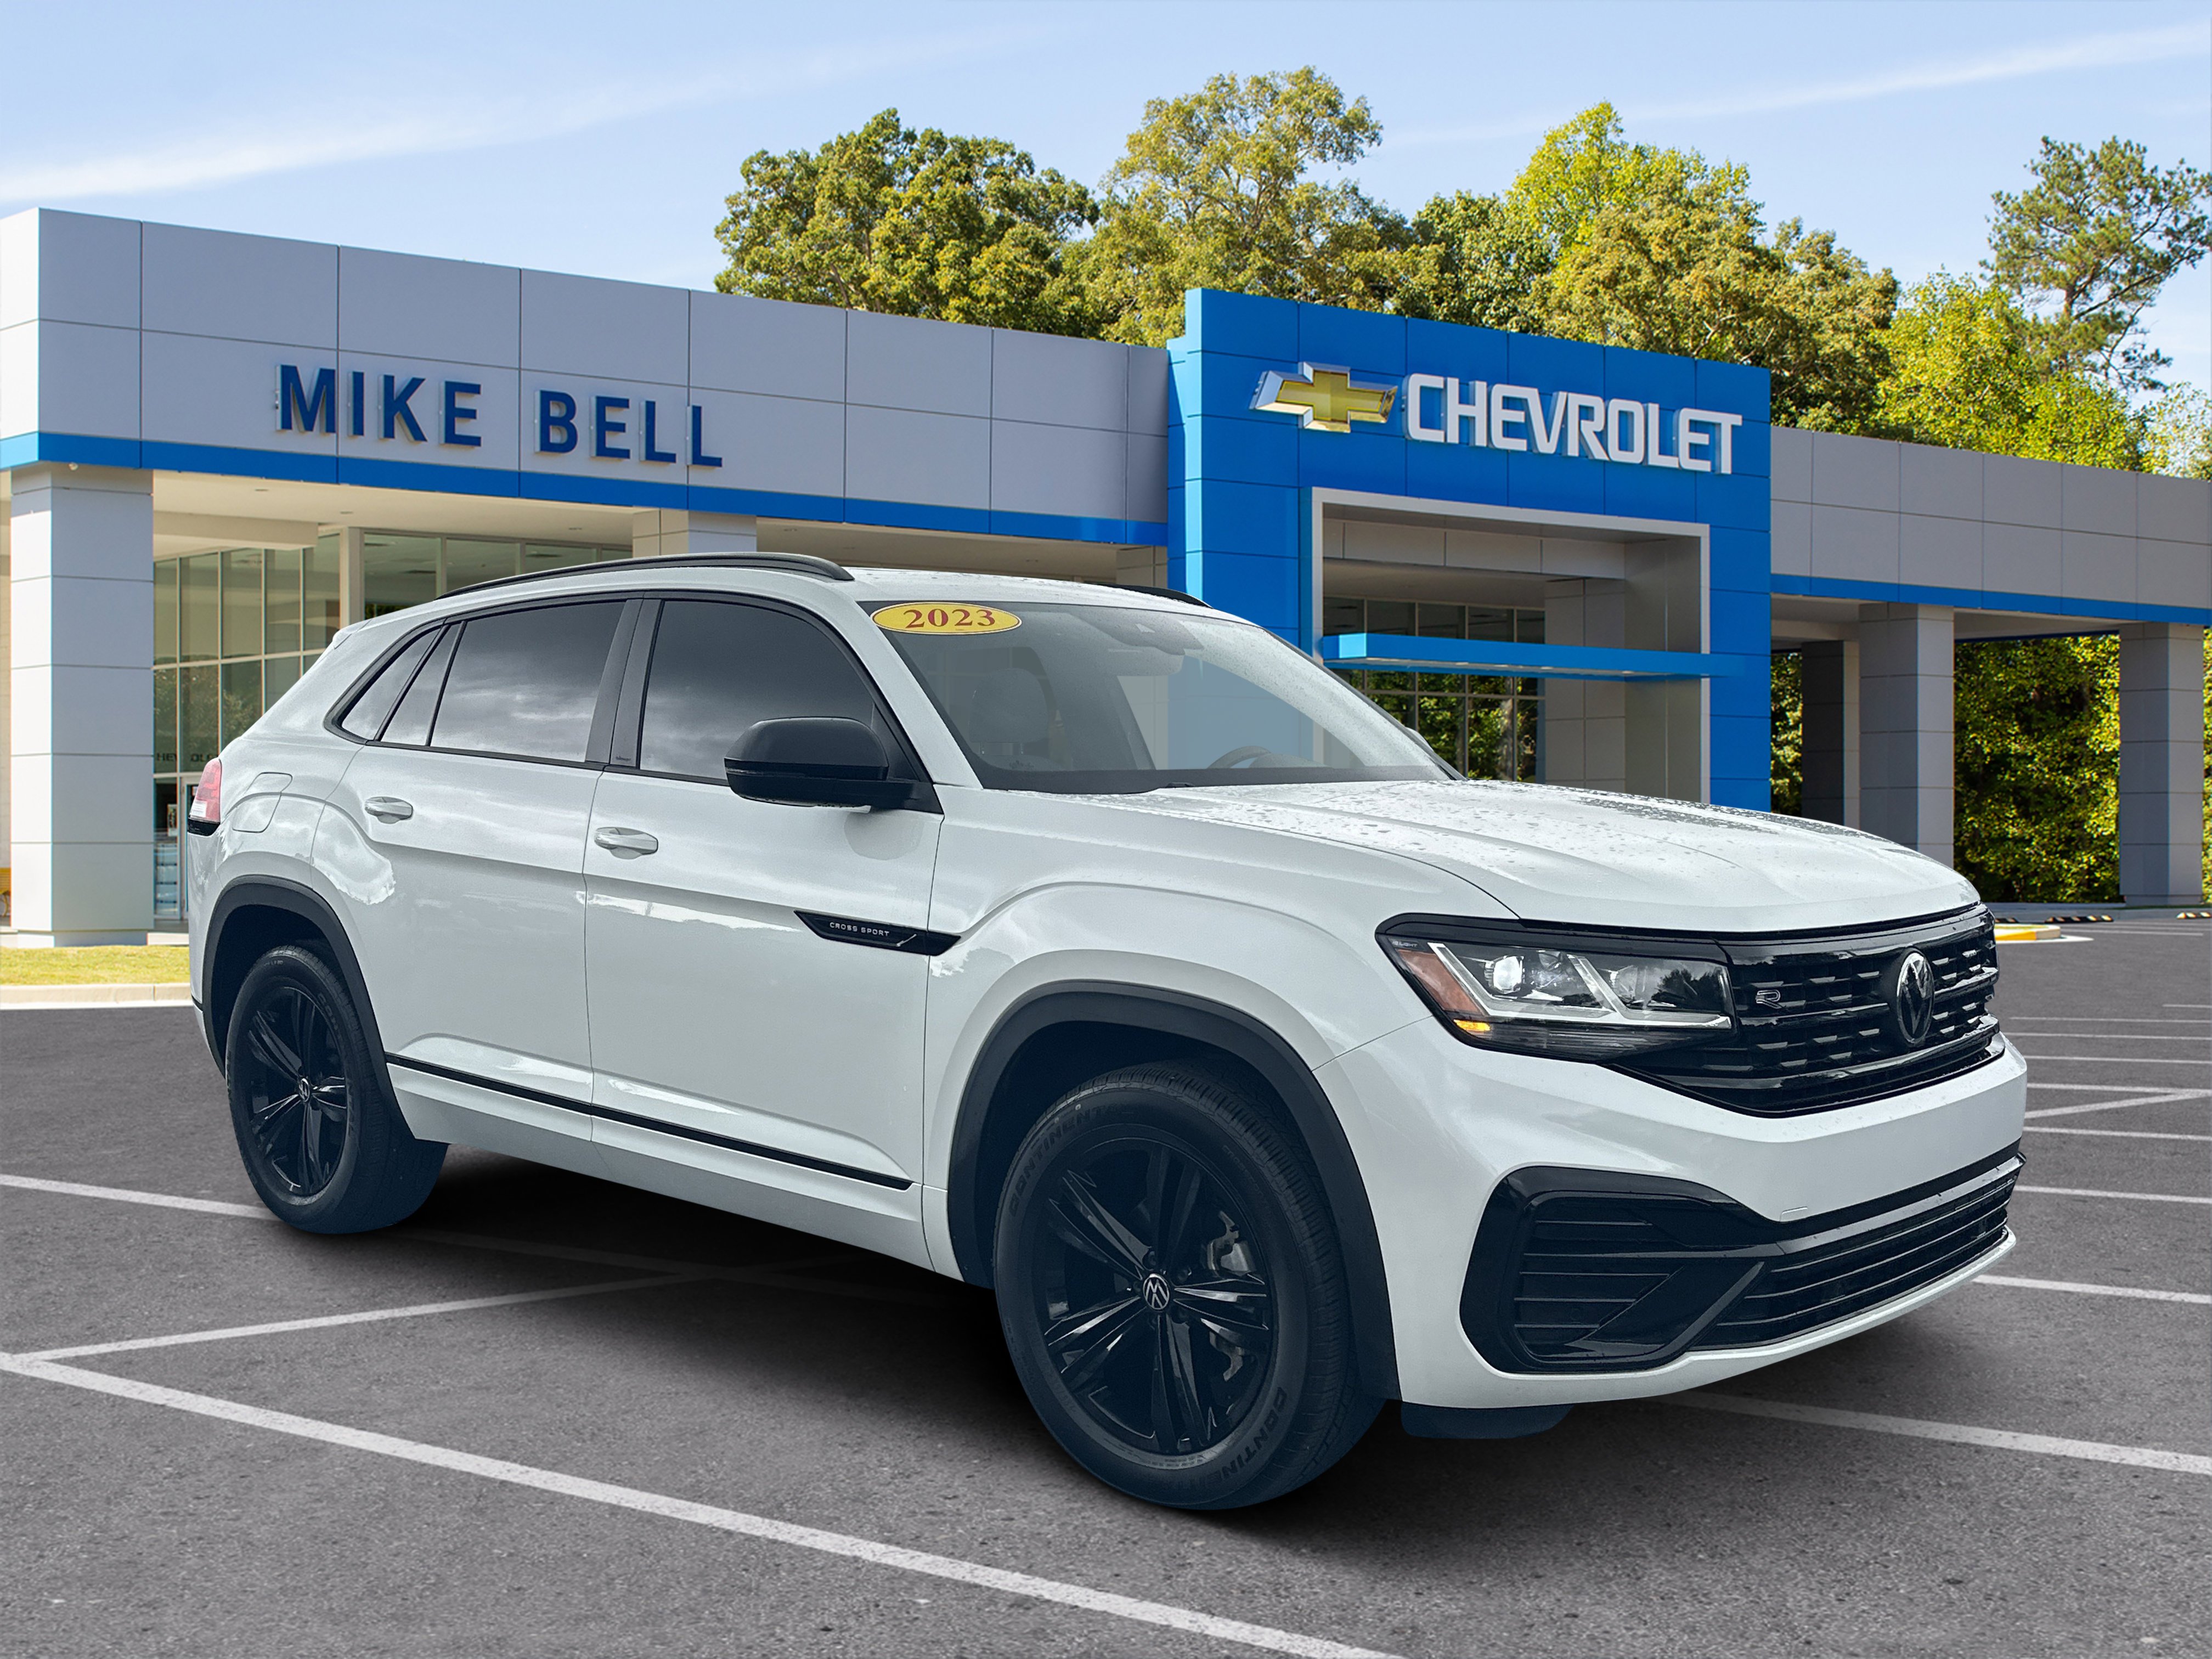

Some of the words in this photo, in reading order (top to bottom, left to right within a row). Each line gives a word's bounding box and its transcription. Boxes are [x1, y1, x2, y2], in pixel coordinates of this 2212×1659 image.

[276, 364, 482, 447] MIKE
[535, 389, 723, 467] BELL
[1402, 373, 1742, 475] CHEVROLET
[904, 608, 996, 628] 2023
[830, 922, 857, 932] CROSS
[861, 927, 890, 936] SPORT
[1756, 989, 1782, 1009] R
